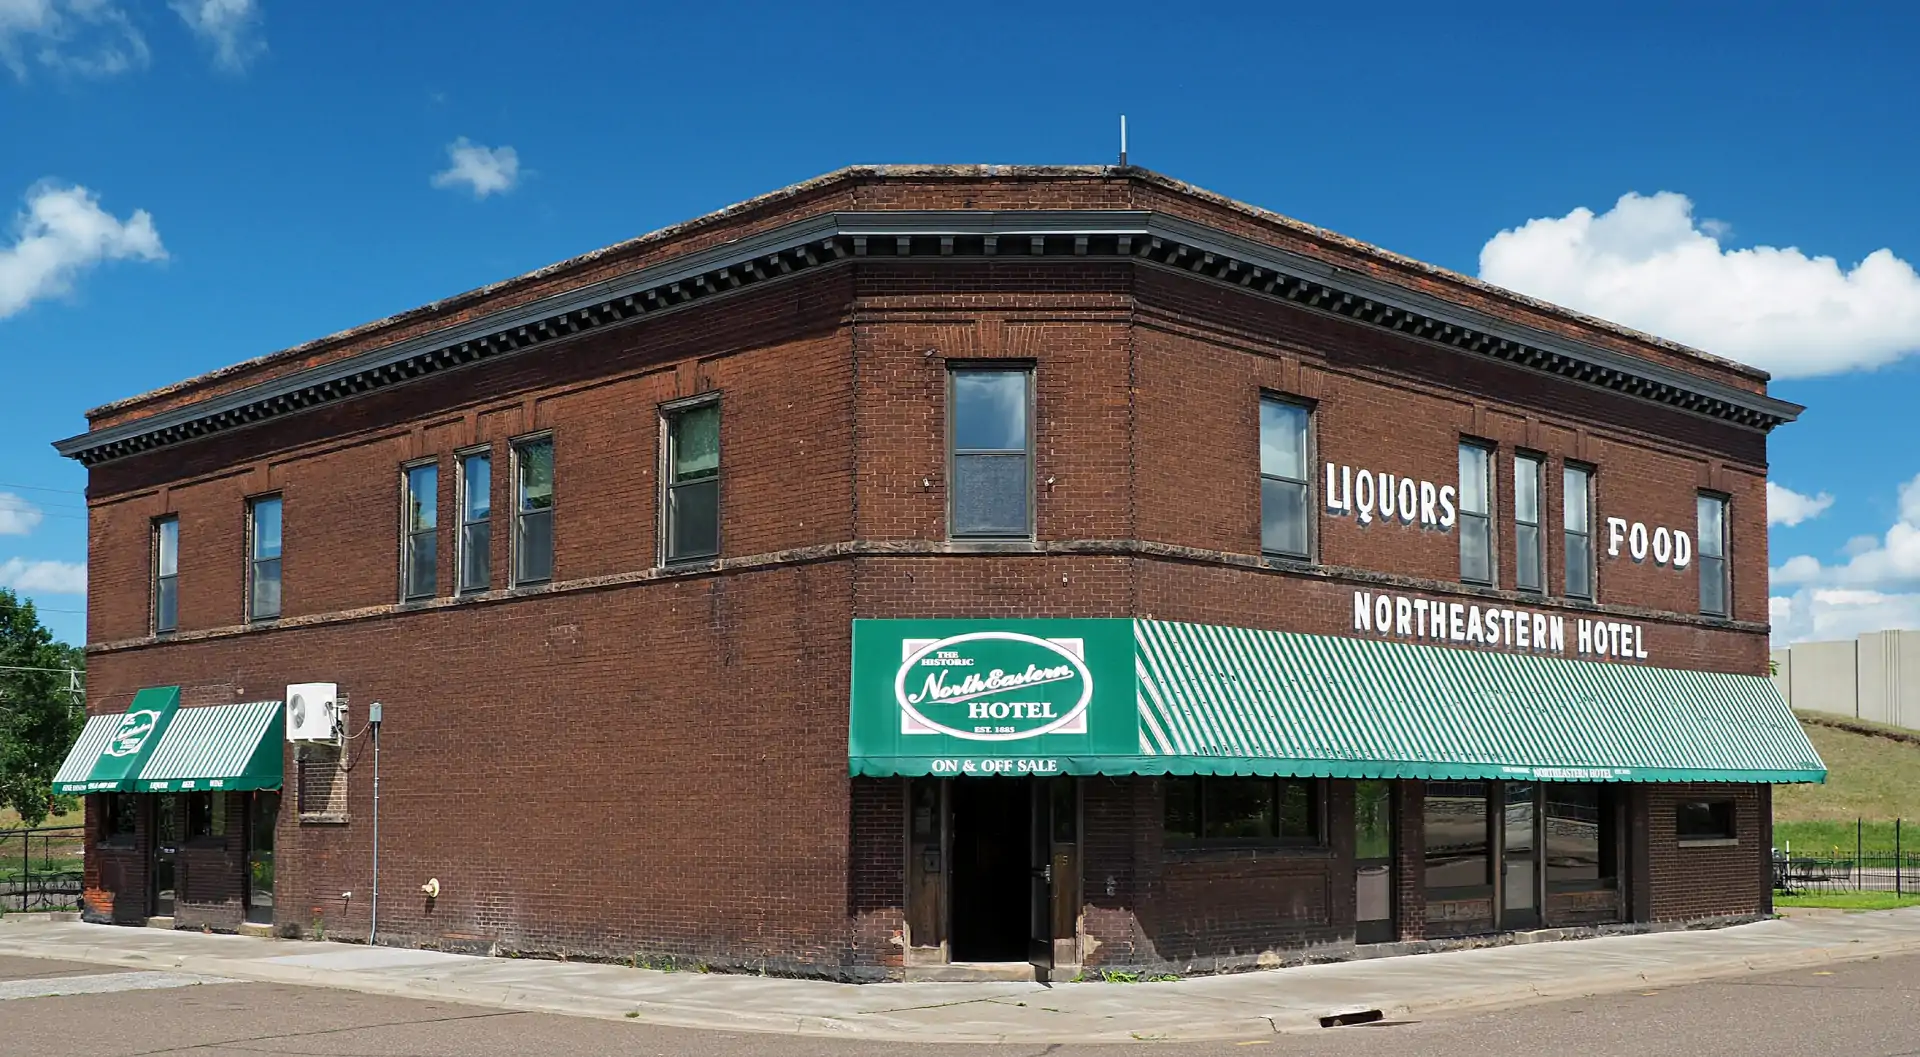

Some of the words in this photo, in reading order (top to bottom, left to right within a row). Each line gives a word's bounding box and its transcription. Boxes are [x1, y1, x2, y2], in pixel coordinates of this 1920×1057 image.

[1326, 462, 1457, 528] LIQUORS
[1606, 517, 1692, 567] FOOD
[1354, 591, 1565, 650] NORTHEASTERN
[1578, 618, 1649, 660] HOTEL
[937, 651, 959, 659] THE
[921, 658, 974, 667] HISTORIC
[968, 702, 1057, 719] HOTEL
[974, 726, 993, 734] EST.
[931, 759, 959, 772] ON
[962, 759, 977, 772] &
[980, 759, 1013, 772] OFF
[1017, 759, 1057, 772] SALE
[1532, 768, 1589, 778] NORTHEASTERN
[1589, 769, 1613, 779] HOTEL
